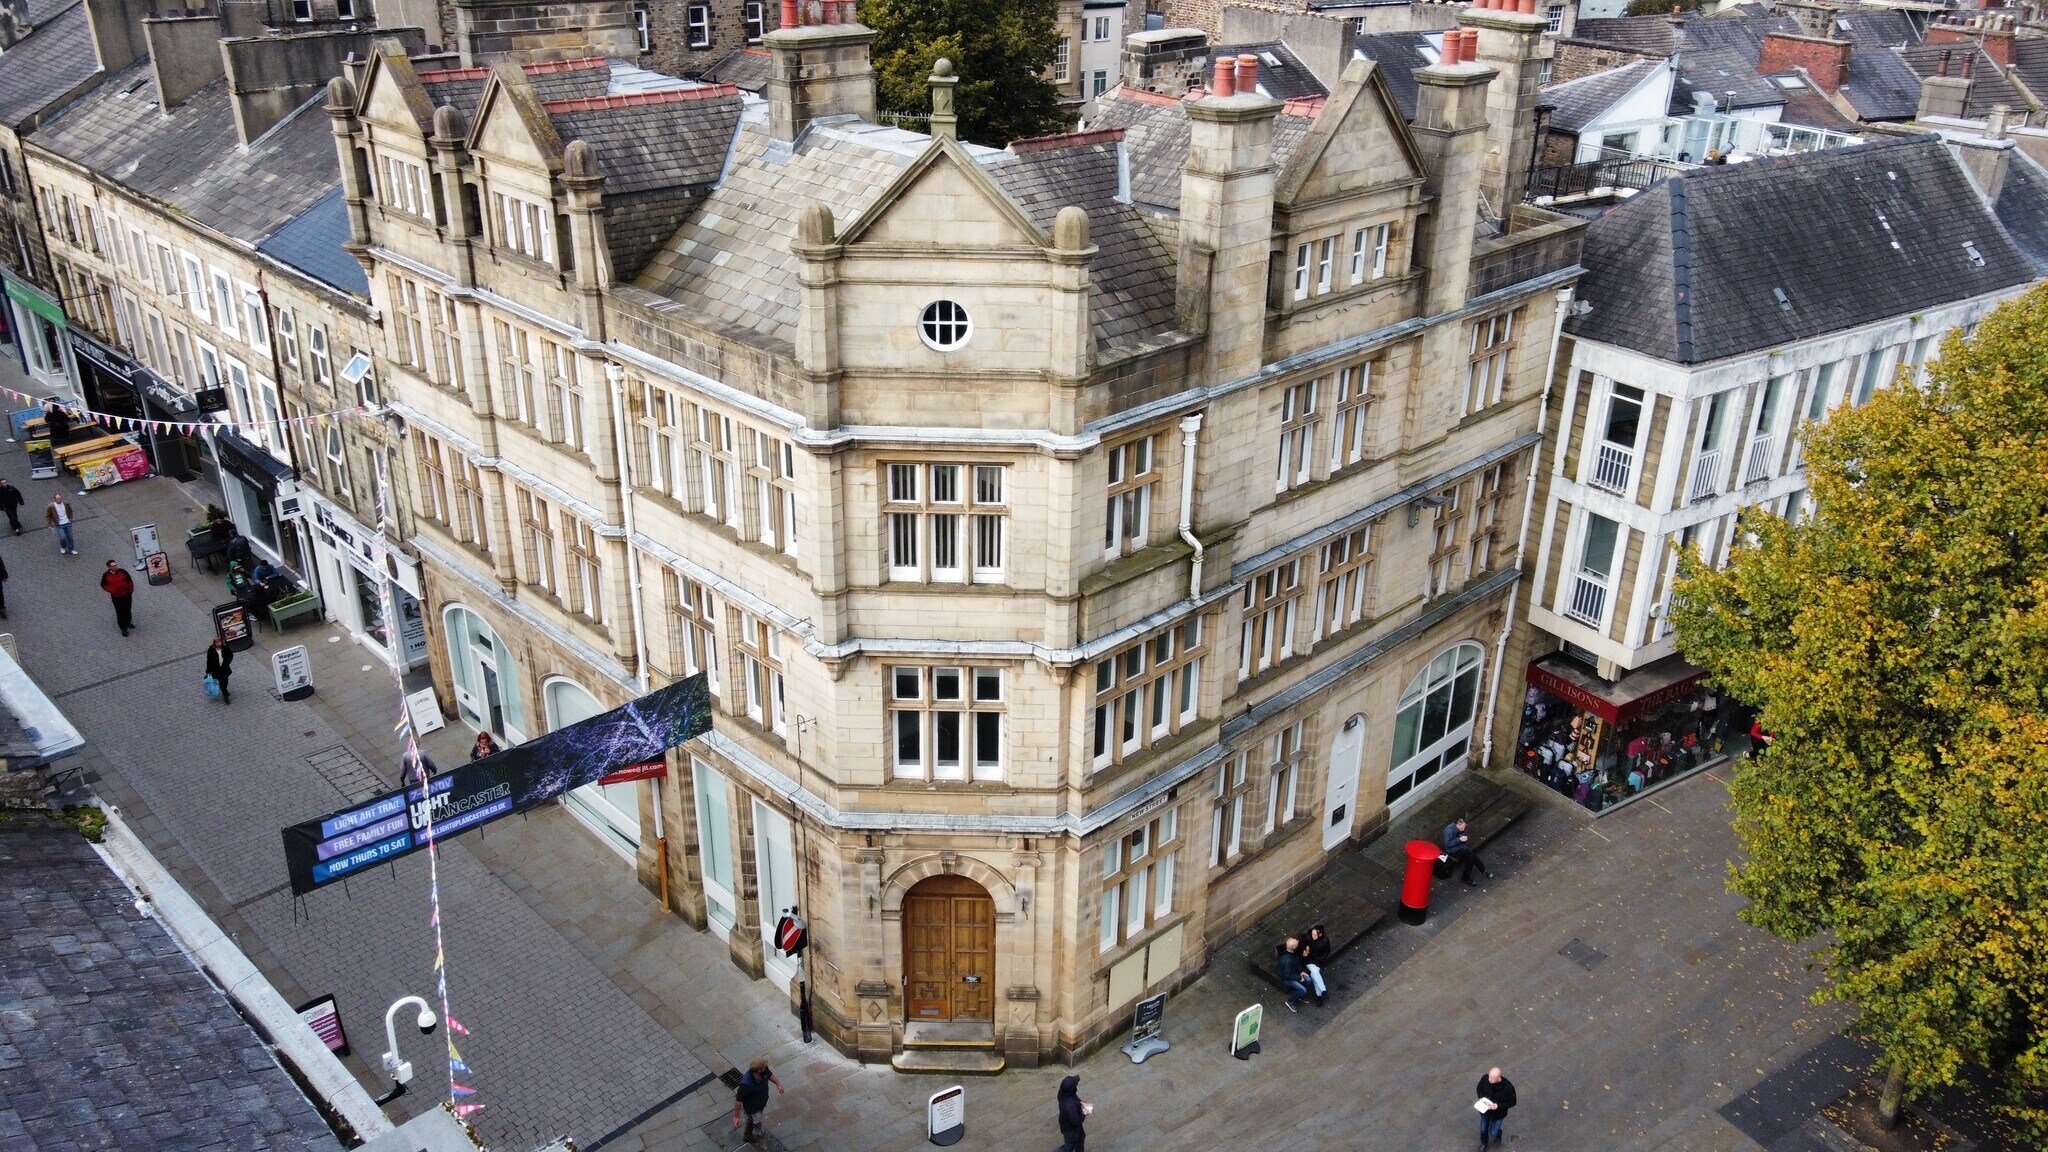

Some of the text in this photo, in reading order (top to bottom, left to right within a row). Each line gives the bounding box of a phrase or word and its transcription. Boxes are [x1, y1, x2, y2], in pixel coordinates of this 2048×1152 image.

[325, 518, 356, 549] FONEZ
[1540, 674, 1600, 710] GILLISONS
[1639, 691, 1664, 711] THE
[334, 801, 401, 831] LIGHT ART TRAIL
[410, 792, 451, 817] LIGHT
[430, 782, 511, 823] LANCASTER
[1131, 796, 1168, 819] NEW STREET
[333, 818, 404, 852] FREE FAMILY FUN
[329, 837, 406, 873] NOW THURS TO SAT
